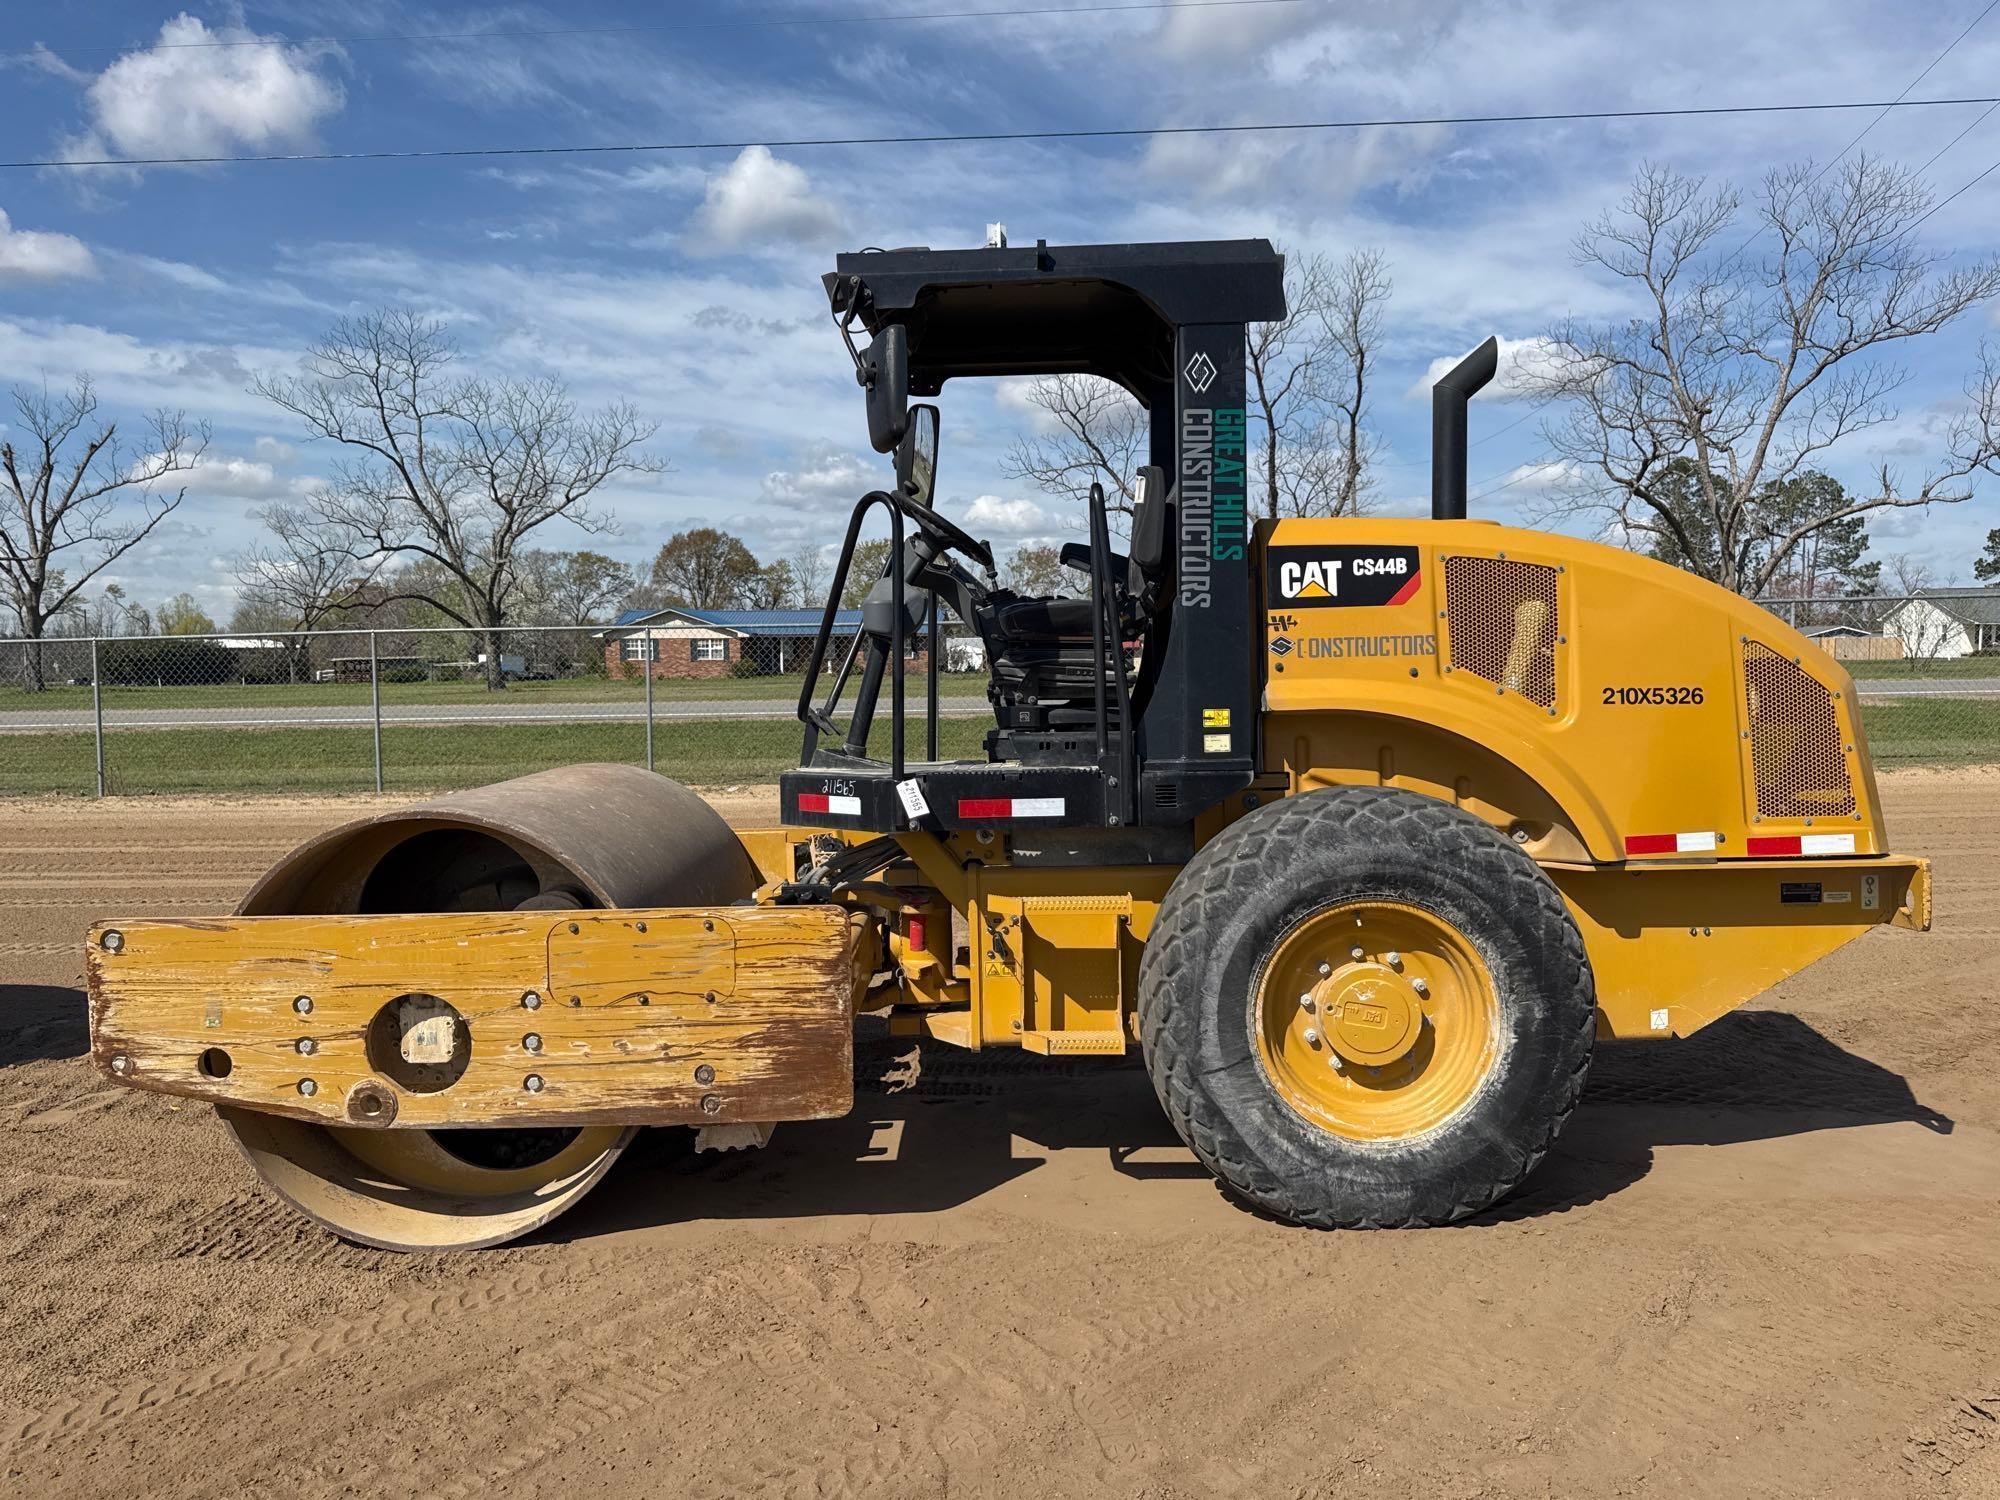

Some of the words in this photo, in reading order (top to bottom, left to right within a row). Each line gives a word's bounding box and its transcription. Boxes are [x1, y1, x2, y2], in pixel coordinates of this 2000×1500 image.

[1214, 408, 1245, 487] GREAT
[1181, 408, 1213, 608] CONSTRUCTORS
[1212, 495, 1244, 561] HILLS
[1280, 560, 1342, 599] CAT
[1352, 557, 1408, 576] CS44B
[1602, 687, 1704, 705] 210X5326
[821, 779, 857, 797] 211565
[905, 786, 923, 811] 211565
